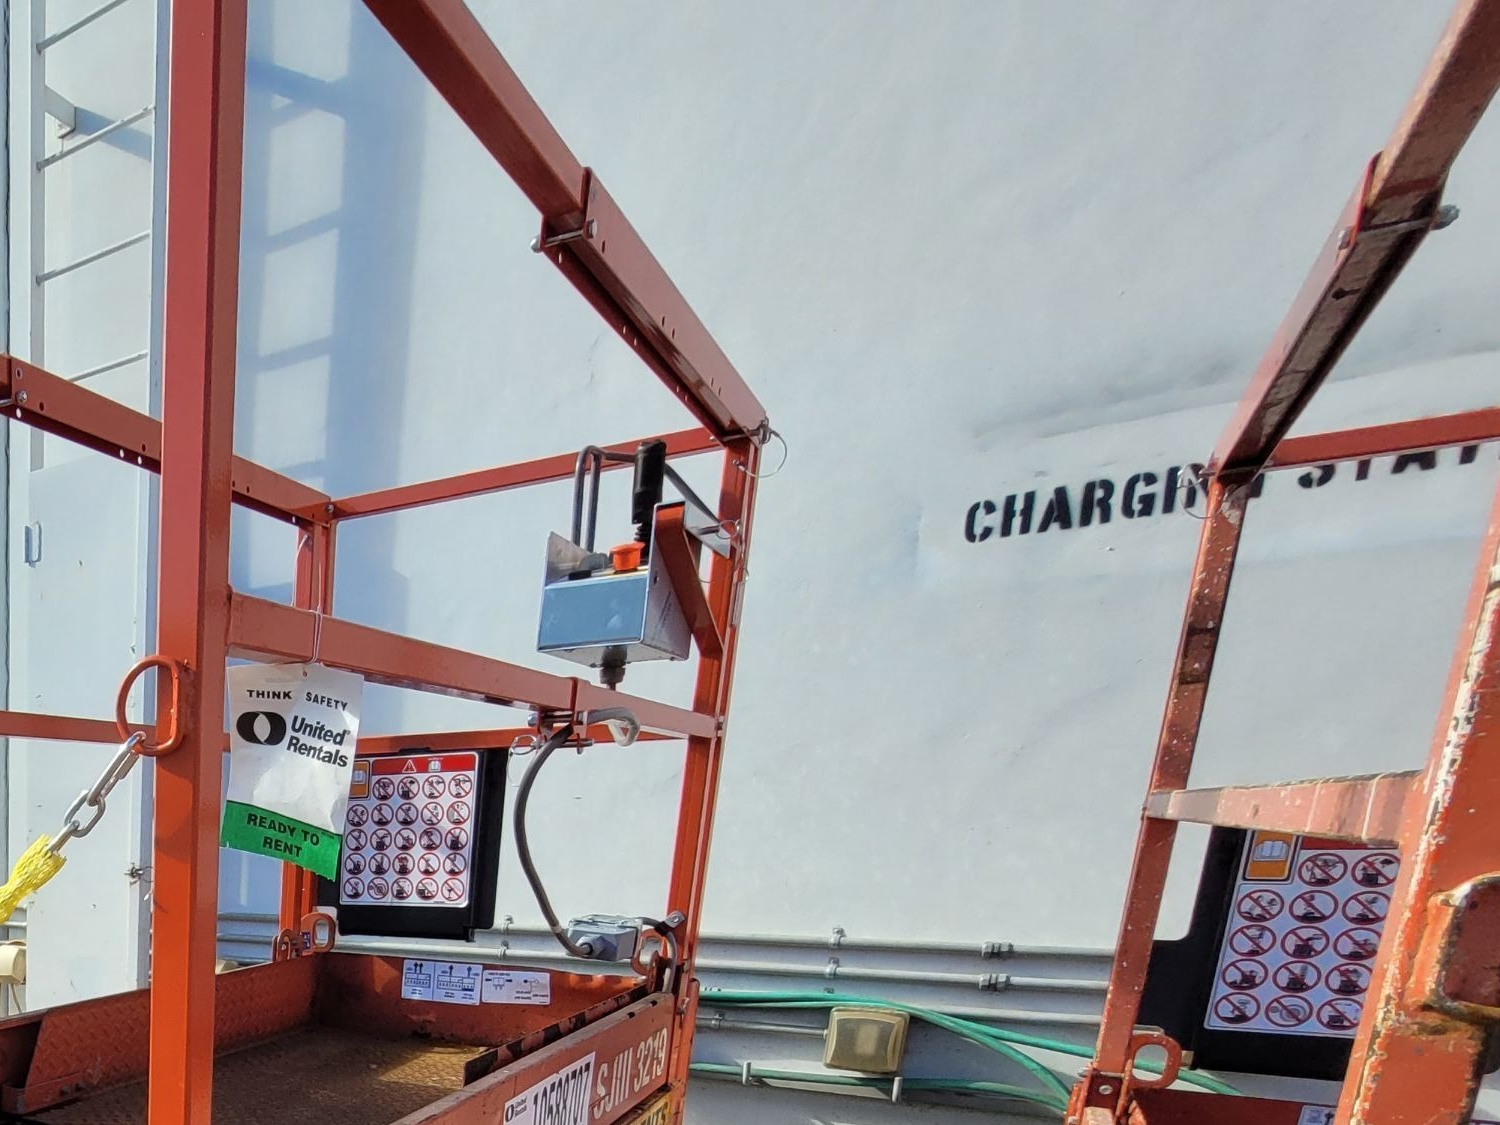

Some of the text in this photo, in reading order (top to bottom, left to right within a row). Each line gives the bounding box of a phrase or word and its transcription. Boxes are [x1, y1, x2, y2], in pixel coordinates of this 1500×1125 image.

[246, 688, 348, 711] THINK SAFETY
[290, 715, 348, 746] United
[286, 735, 349, 767] Rentals
[246, 811, 320, 846] READY TO
[262, 835, 303, 858] RENT
[633, 1026, 668, 1093] 3219
